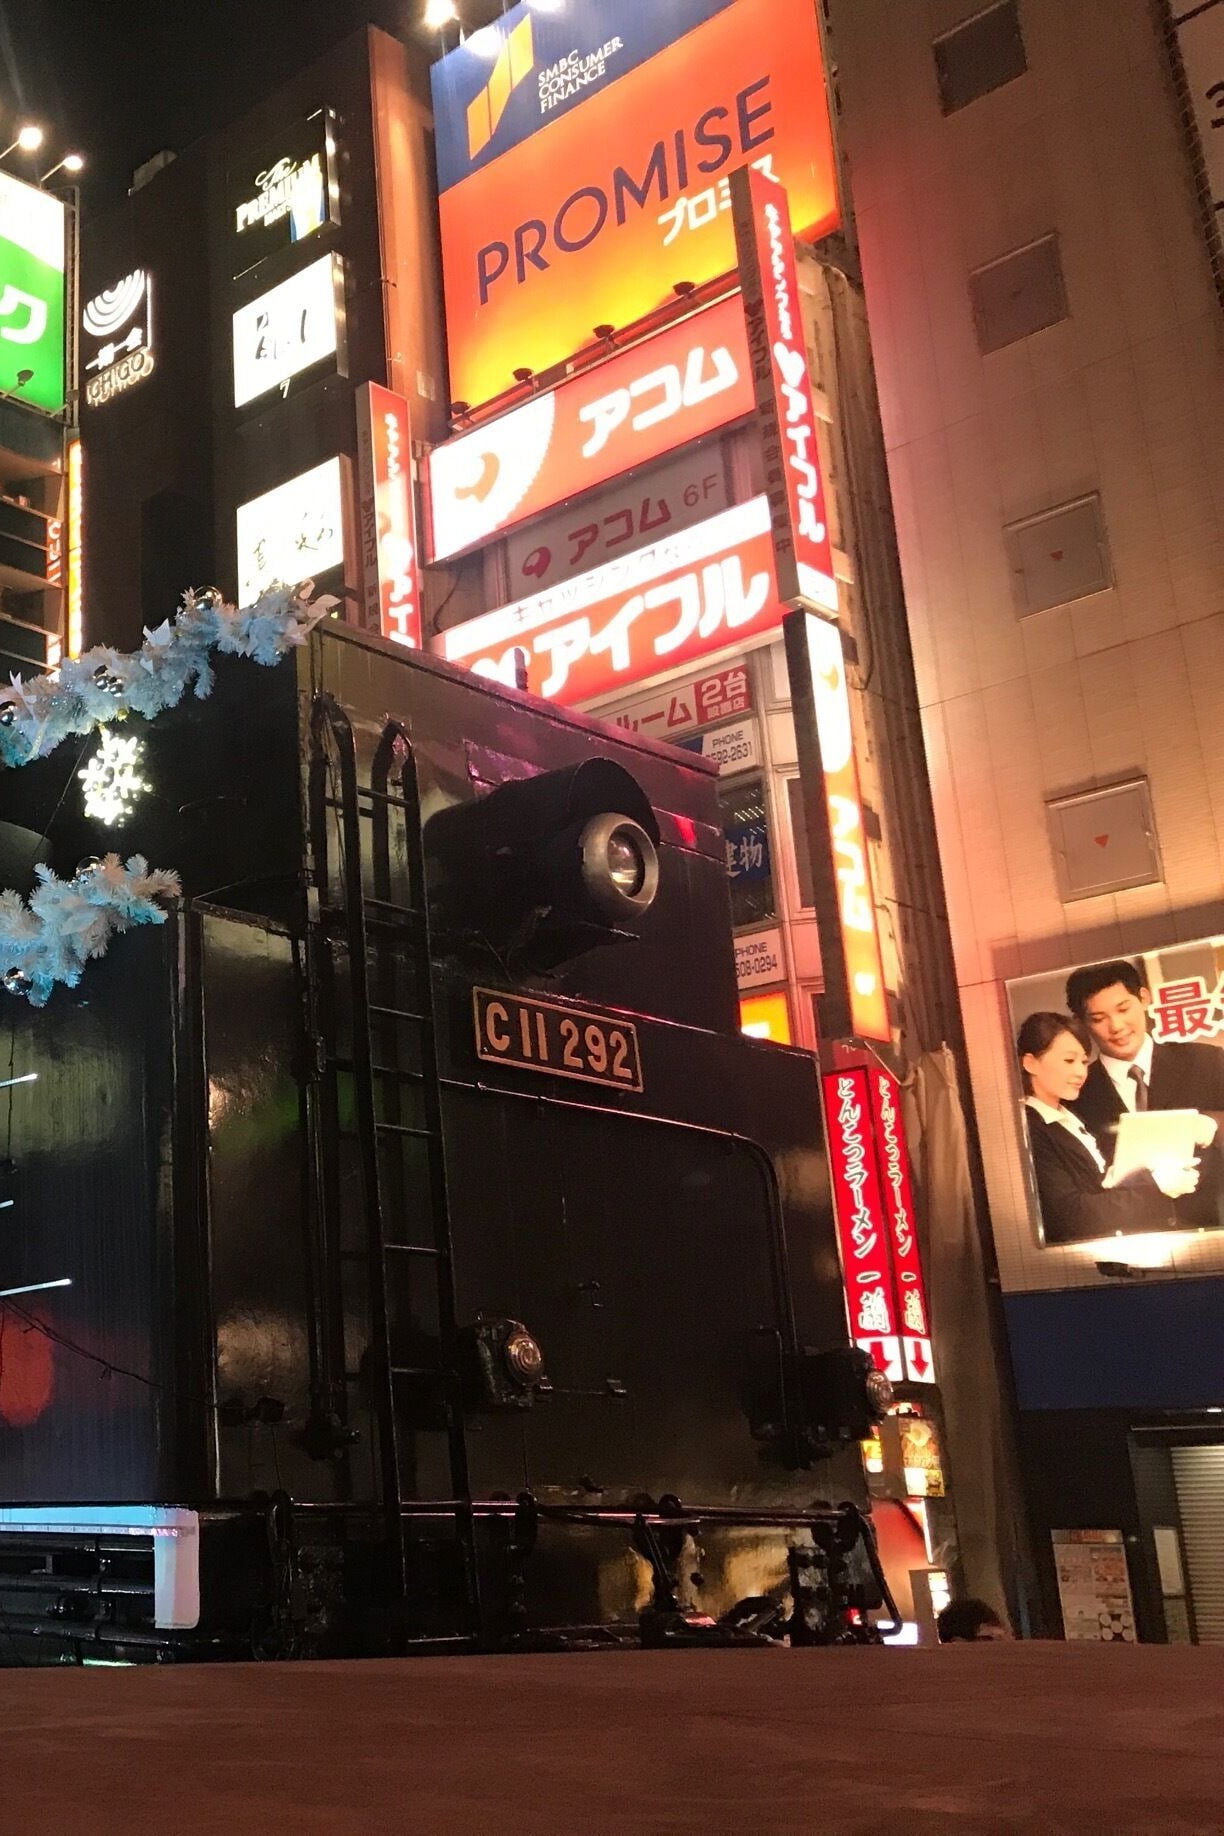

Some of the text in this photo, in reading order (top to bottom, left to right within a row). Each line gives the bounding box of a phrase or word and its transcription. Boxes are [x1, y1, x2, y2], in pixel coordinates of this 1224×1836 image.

[538, 36, 624, 99] CONSUMER
[538, 49, 579, 87] SMBC
[541, 61, 607, 114] FINANCE
[477, 75, 776, 306] PROMISE
[579, 346, 738, 458] アコム
[779, 381, 827, 545] アイフル
[567, 474, 720, 566] アコム 6F
[532, 554, 770, 699] アイフル
[701, 671, 747, 707] 2台
[712, 730, 744, 748] PHONE
[735, 942, 768, 958] PHONE
[560, 1019, 633, 1079] 292
[837, 1076, 877, 1260] とんこつラーメン
[878, 1075, 913, 1259] とんこつラーメン
